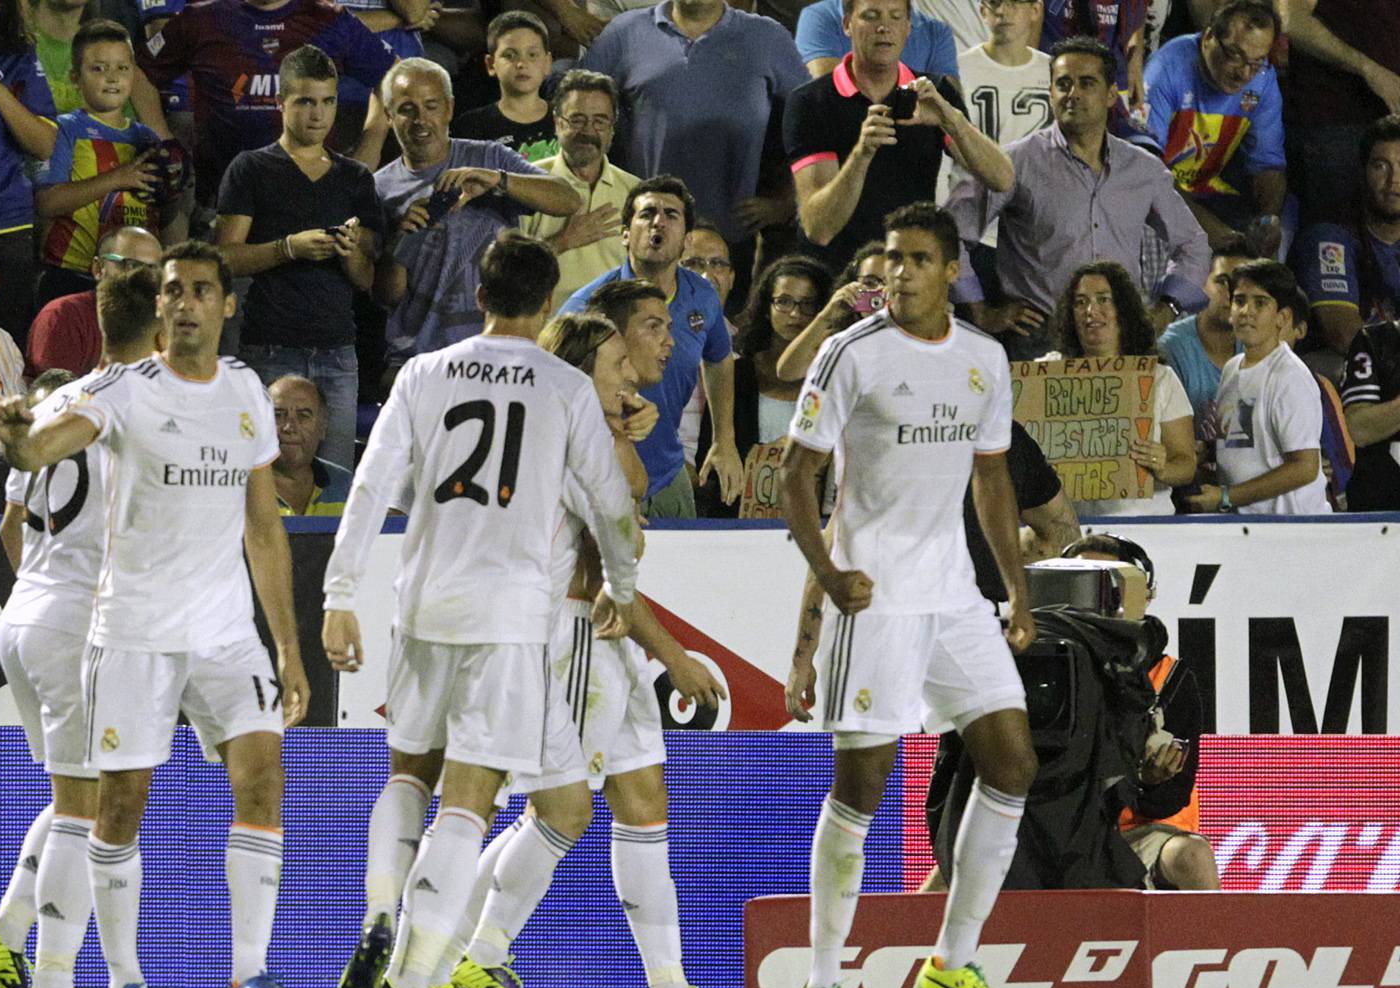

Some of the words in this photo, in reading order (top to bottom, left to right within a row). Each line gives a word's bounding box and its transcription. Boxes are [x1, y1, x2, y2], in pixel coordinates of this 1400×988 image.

[447, 361, 536, 387] MORATA
[1009, 361, 1048, 378] OR
[1354, 352, 1372, 379] 3
[1044, 375, 1123, 417] RAMOS
[932, 403, 958, 420] Fly
[897, 420, 978, 445] Emirate
[1025, 416, 1132, 460] UESTRAS
[200, 446, 228, 463] Fly
[434, 399, 526, 508] 21
[164, 463, 248, 487] Emirate
